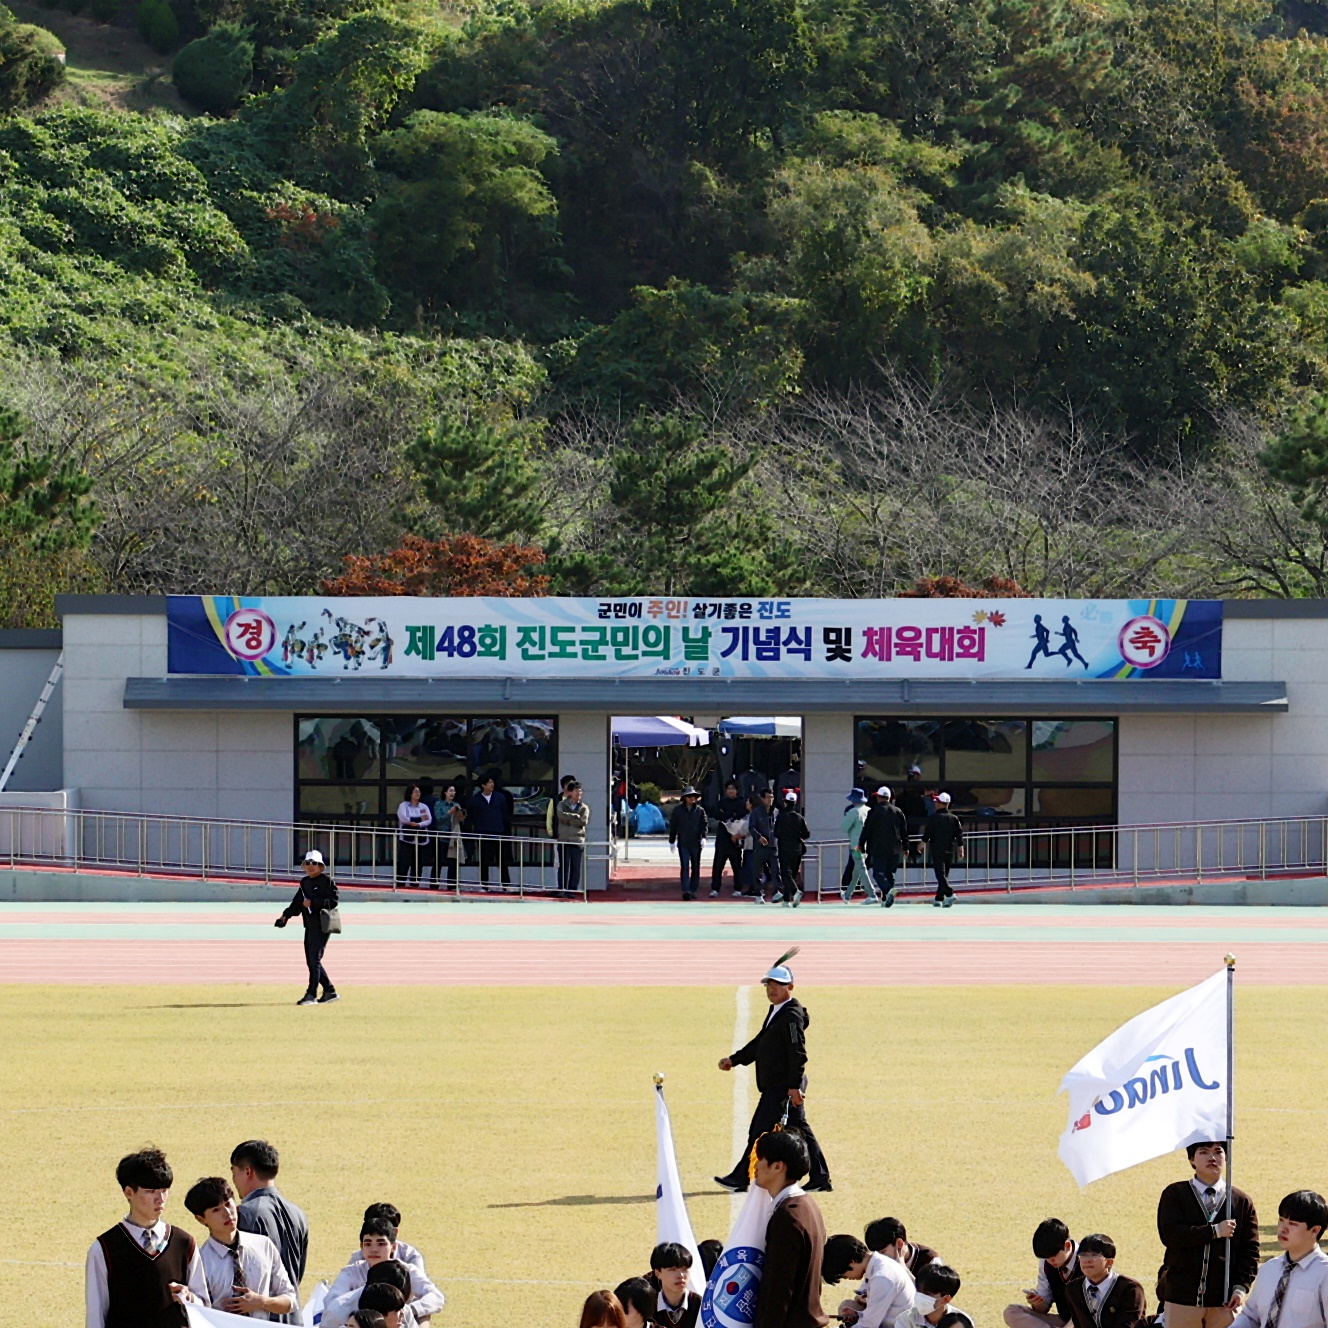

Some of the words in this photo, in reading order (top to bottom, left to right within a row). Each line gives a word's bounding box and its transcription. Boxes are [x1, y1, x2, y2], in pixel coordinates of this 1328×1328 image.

[597, 602, 643, 620] 군민이
[647, 600, 688, 620] 주인!
[692, 602, 753, 620] 살기좋은
[757, 601, 791, 620] 진도
[236, 618, 264, 650] 경
[404, 624, 508, 661] 제48회
[516, 624, 672, 661] 진도군민의
[681, 624, 712, 661] 날
[721, 625, 813, 662] 기념식
[822, 626, 853, 662] 및
[861, 625, 986, 663] 체육대회
[1128, 625, 1162, 658] 축
